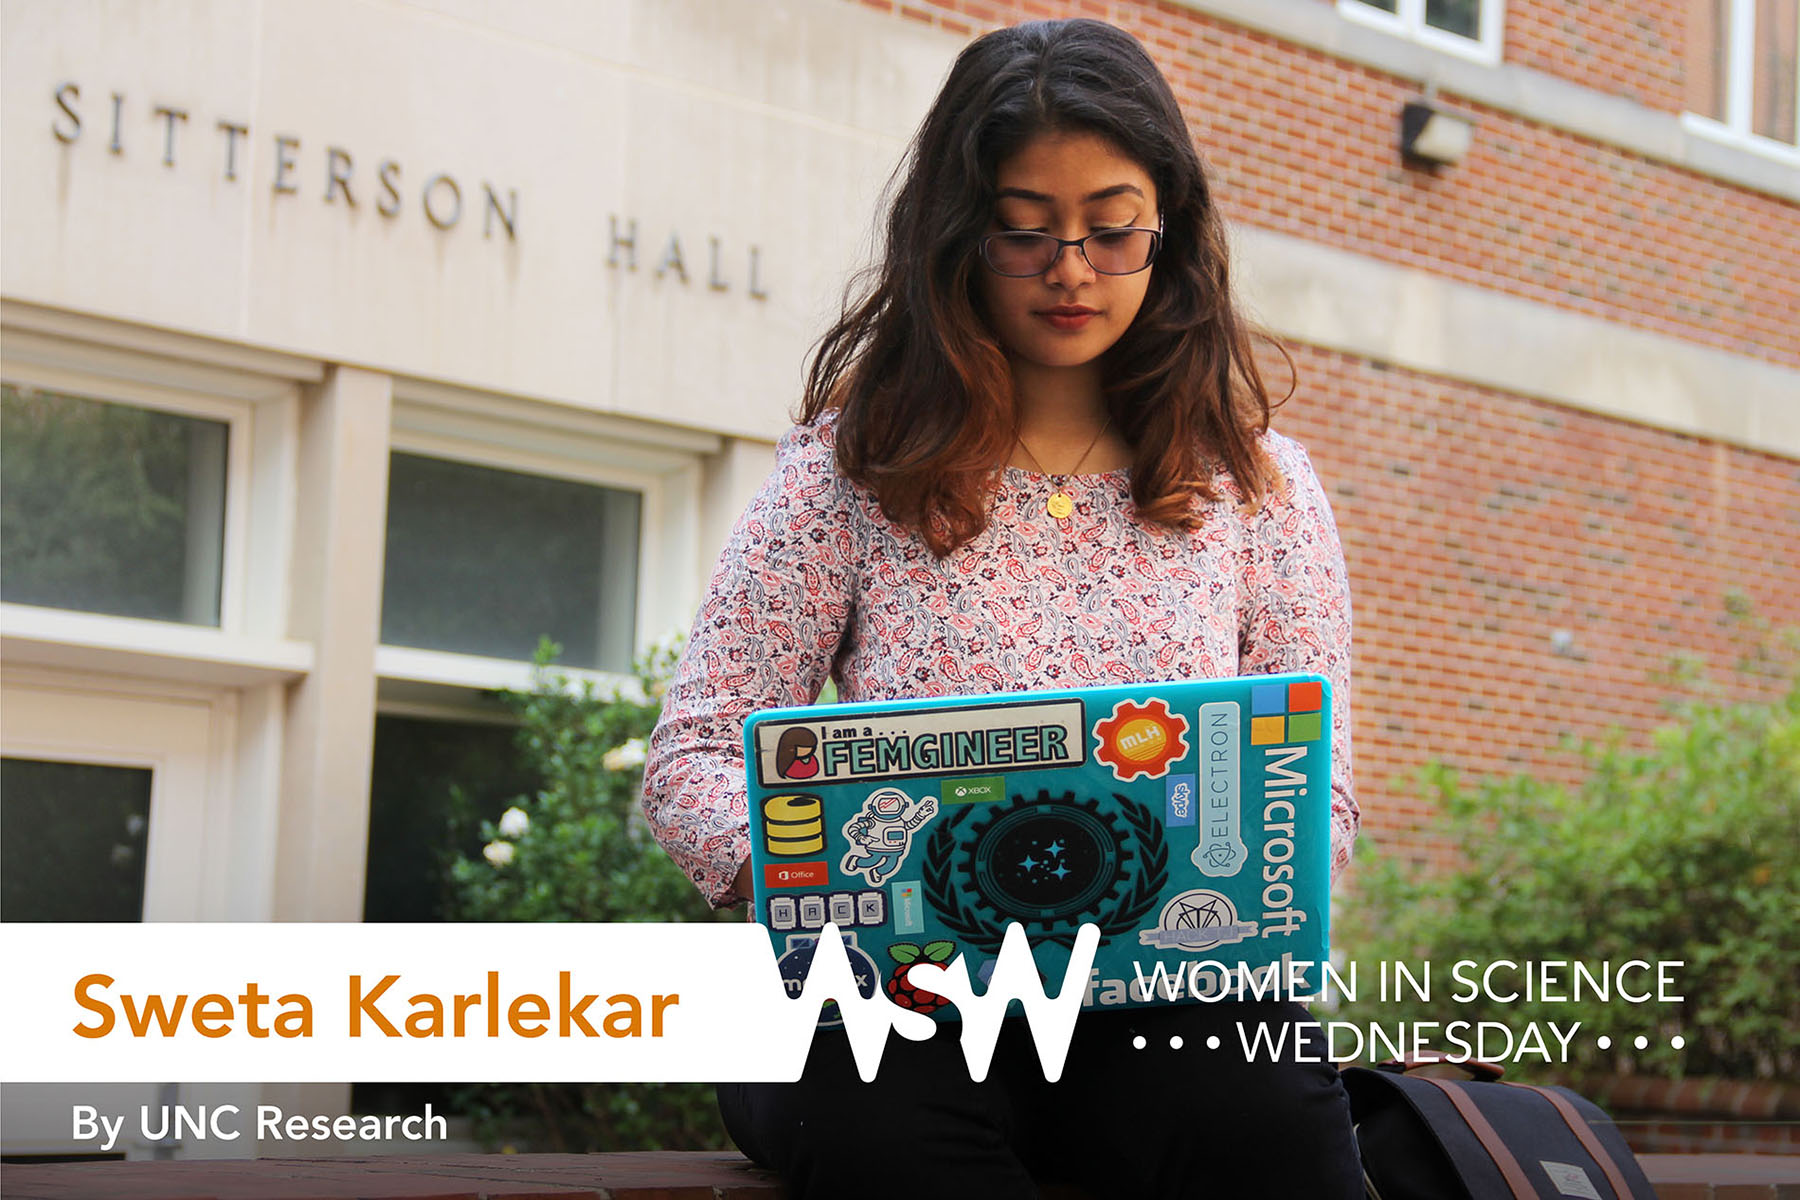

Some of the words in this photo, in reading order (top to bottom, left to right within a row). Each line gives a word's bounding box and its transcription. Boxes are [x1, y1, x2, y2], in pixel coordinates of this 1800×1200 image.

[51, 82, 521, 241] SITTERSON
[606, 213, 768, 300] HALL
[821, 726, 827, 739] I
[832, 727, 857, 738] am
[822, 724, 1069, 777] FEMGINEER
[968, 786, 992, 795] XBOX
[1172, 783, 1191, 817] skype
[1211, 712, 1229, 838] ELECTRON
[1262, 746, 1308, 939] Microsoft
[790, 871, 815, 879] Office
[1083, 952, 1312, 1008] facebook
